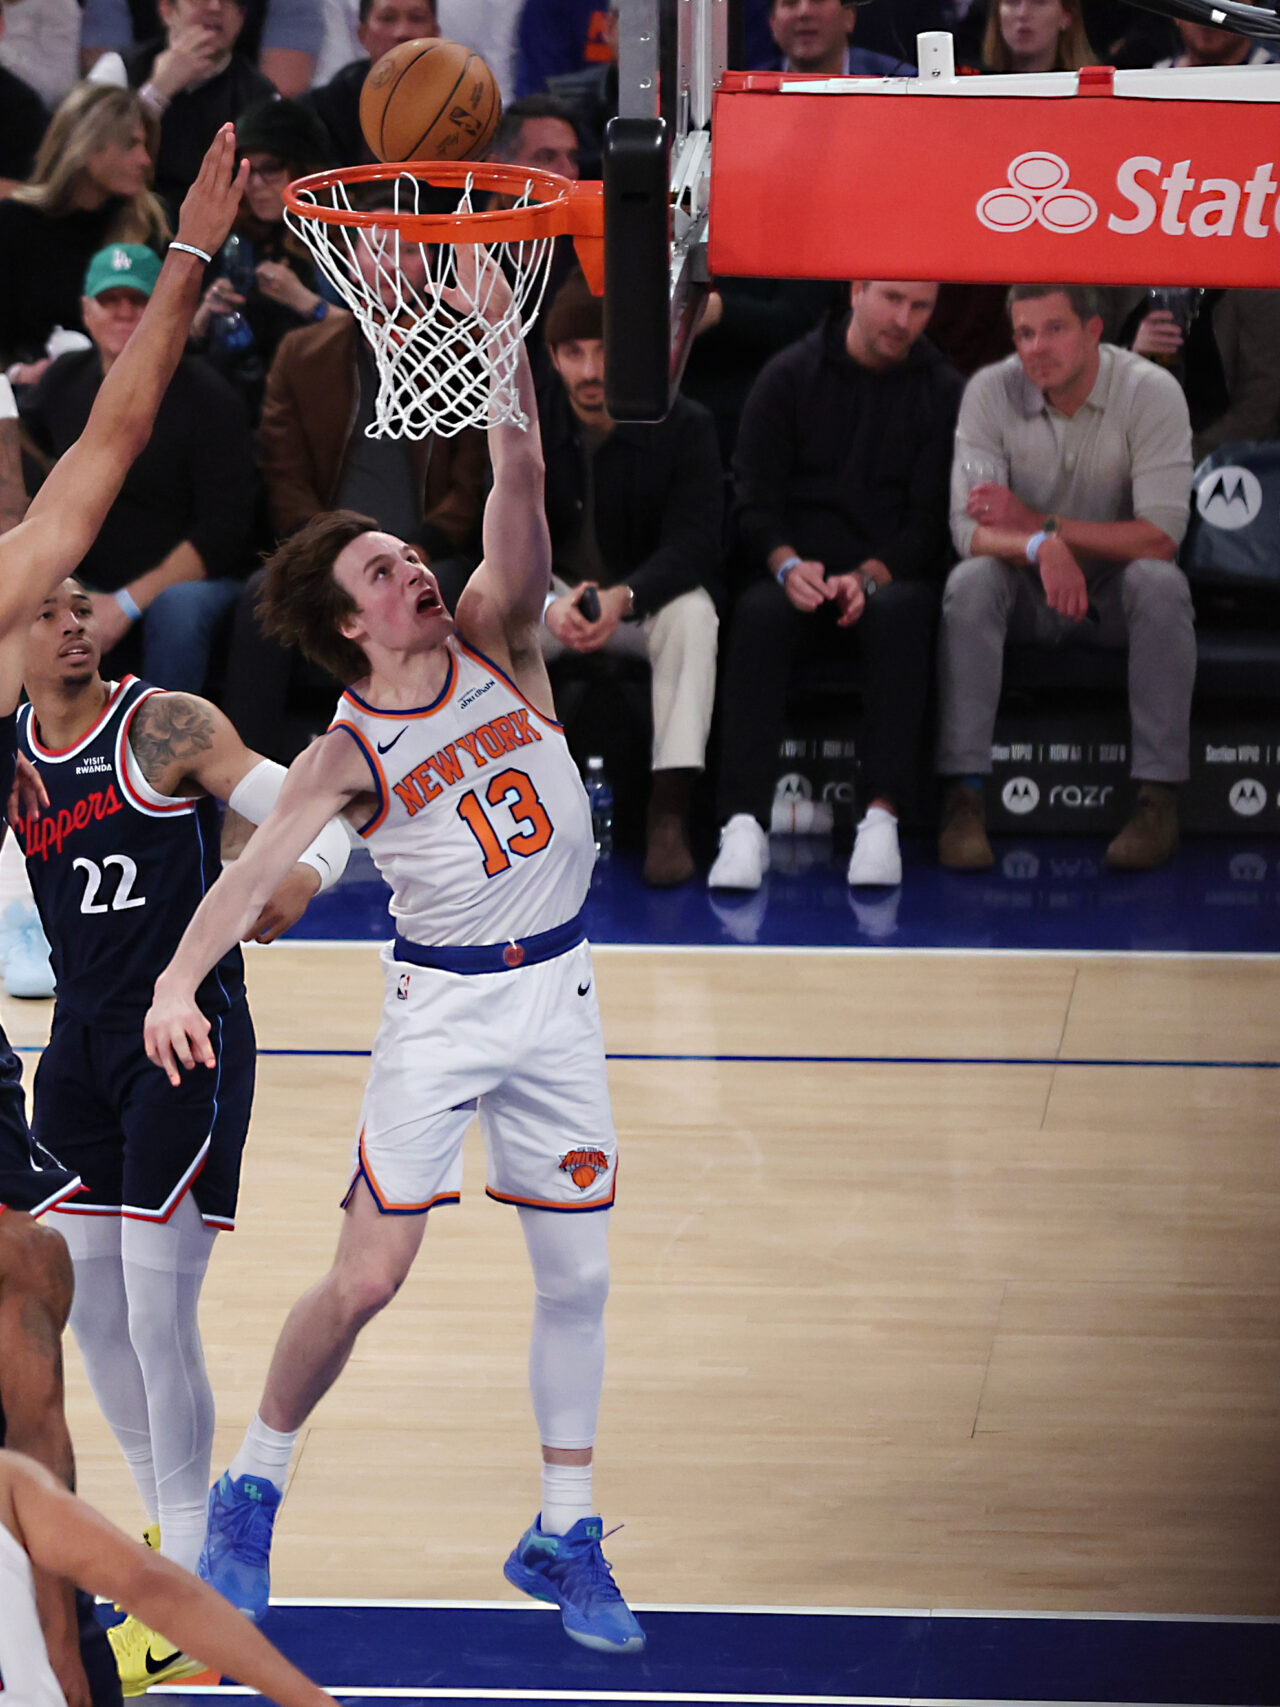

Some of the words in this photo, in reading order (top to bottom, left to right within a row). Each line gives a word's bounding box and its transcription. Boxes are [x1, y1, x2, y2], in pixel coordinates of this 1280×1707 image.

[1107, 155, 1280, 238] Stat
[112, 248, 133, 271] LA
[75, 763, 113, 775] RWANDA
[83, 756, 105, 766] VISIT
[392, 744, 465, 816] NEW
[455, 708, 543, 767] YORK
[1049, 784, 1114, 808] razr
[456, 767, 554, 879] 13
[72, 854, 146, 914] 22
